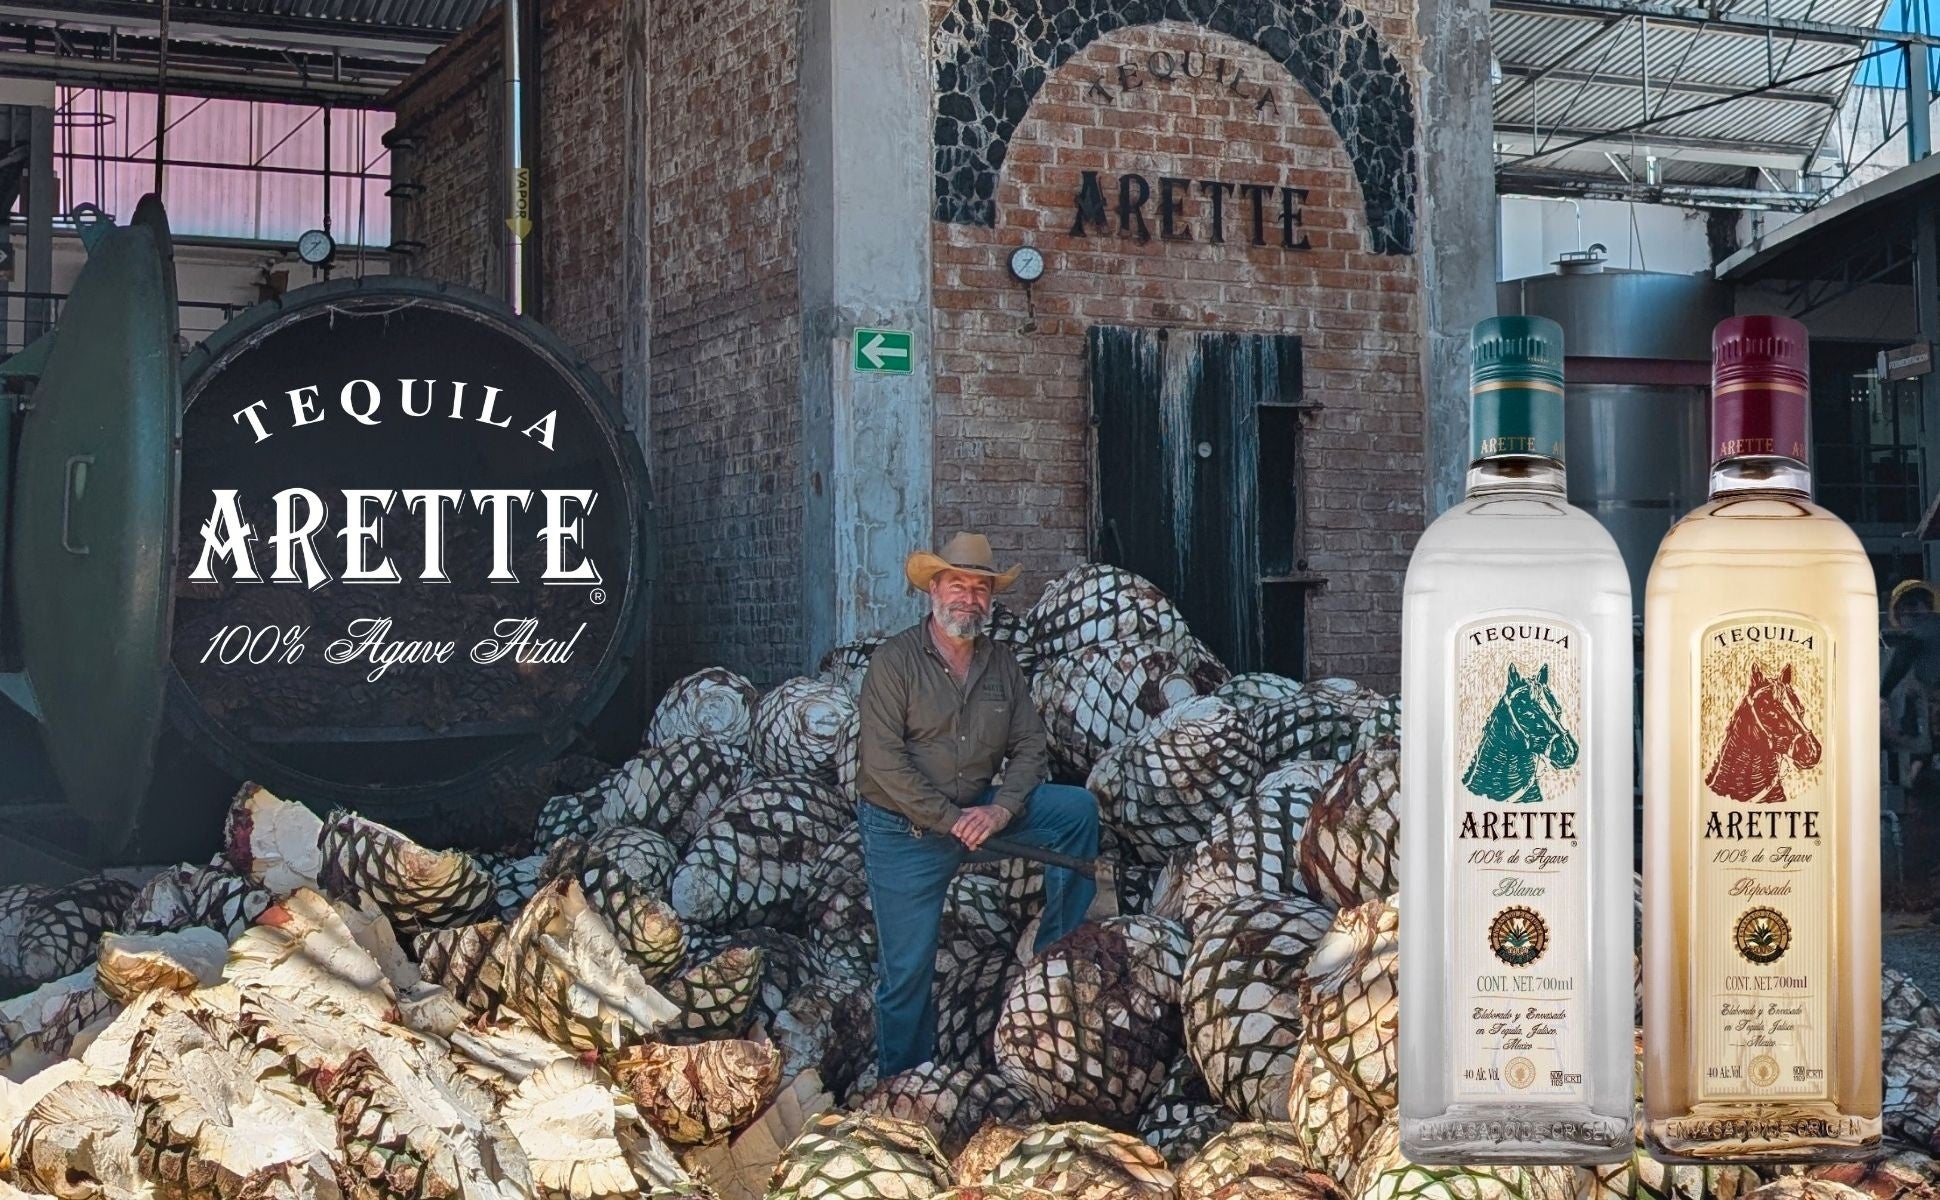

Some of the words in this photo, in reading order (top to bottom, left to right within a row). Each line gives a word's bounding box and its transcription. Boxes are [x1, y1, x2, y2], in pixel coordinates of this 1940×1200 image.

[1088, 50, 1280, 117] TEQUILA
[515, 171, 528, 219] VAPOR
[1069, 171, 1312, 251] ARETTE
[1481, 437, 1536, 455] ARETTE
[1720, 438, 1774, 456] ARETTE
[1469, 625, 1569, 649] TEQUILA
[1714, 626, 1813, 650] TEQUILA
[1459, 811, 1577, 841] ARETTE
[1704, 810, 1820, 841] ARETTE
[1467, 849, 1505, 864] 100%
[1507, 849, 1520, 864] de
[1525, 847, 1569, 870] Agave
[1712, 848, 1749, 863] 100%
[1751, 848, 1764, 863] de
[1769, 846, 1812, 869] Agave
[1492, 876, 1545, 897] Blanco
[1728, 876, 1792, 902] Reposado
[1477, 975, 1508, 992] CONT.
[1725, 975, 1752, 991] CONT.
[1472, 1007, 1512, 1020] Elaborado
[1512, 1012, 1521, 1023] y
[1526, 1007, 1566, 1020] Envasado
[1721, 1003, 1756, 1016] Elaborado
[1756, 1008, 1764, 1019] y
[1475, 1027, 1485, 1035] en
[1463, 1068, 1474, 1079] 40
[1706, 1067, 1718, 1078] 40
